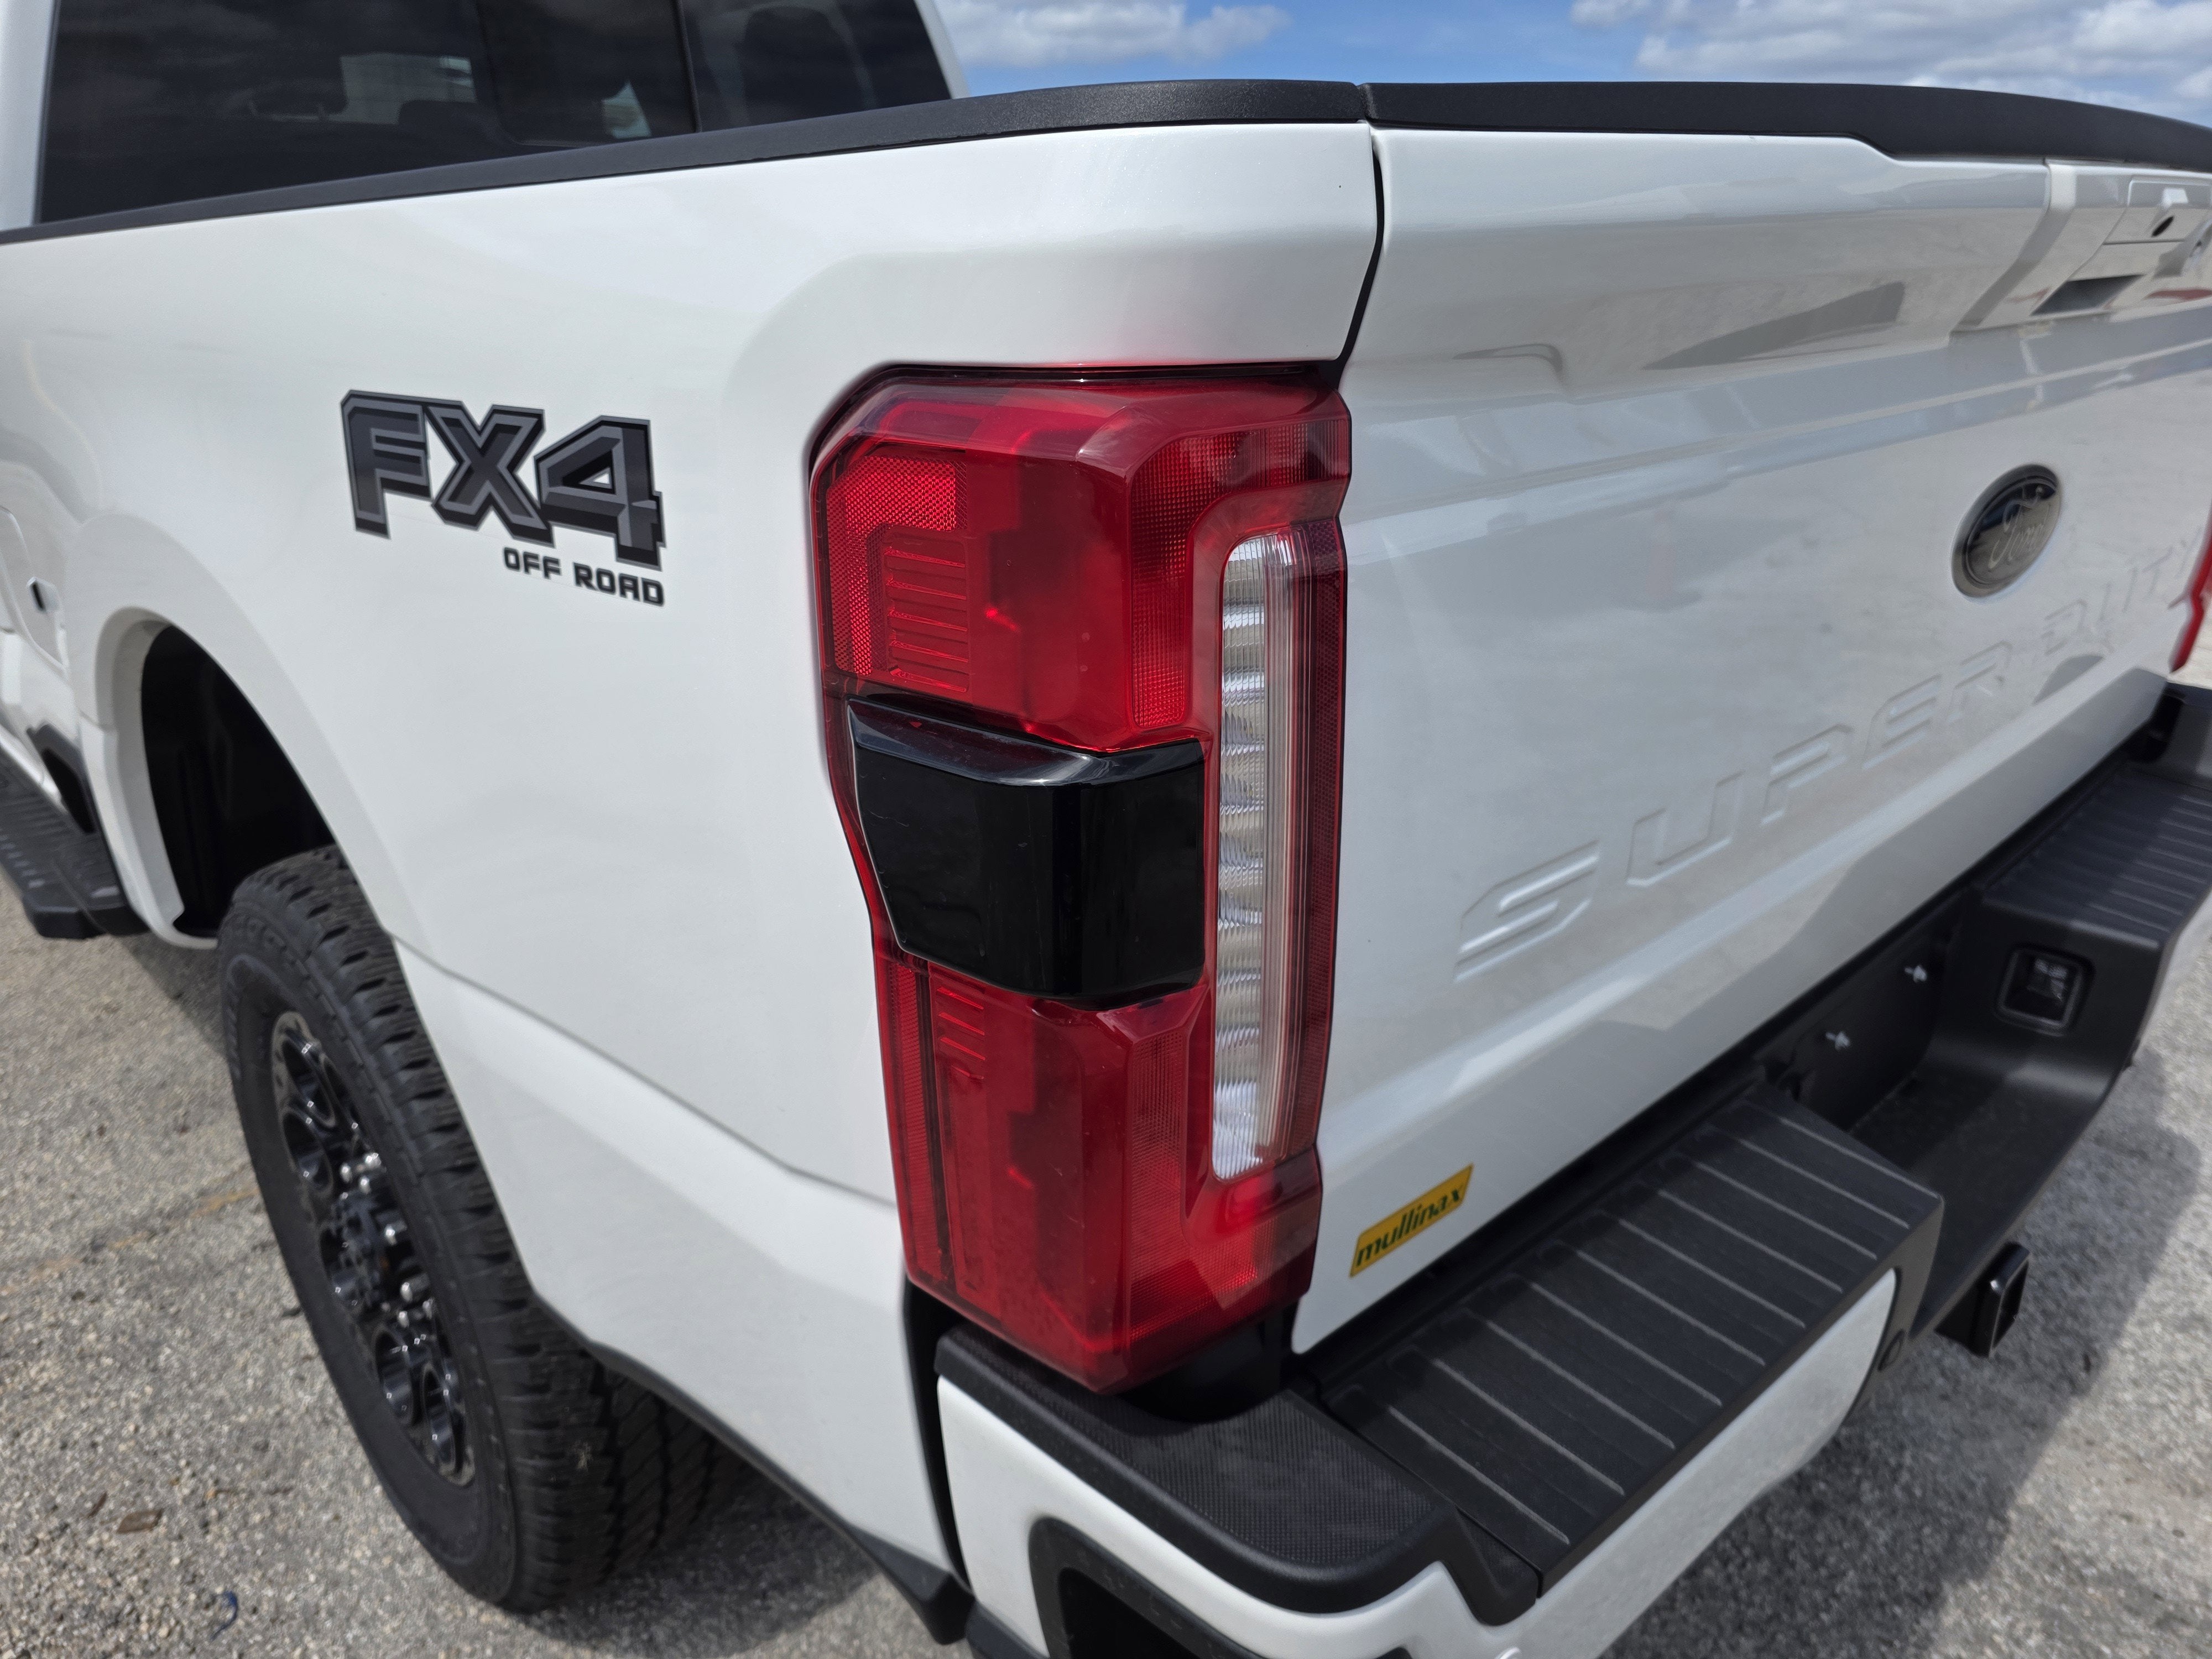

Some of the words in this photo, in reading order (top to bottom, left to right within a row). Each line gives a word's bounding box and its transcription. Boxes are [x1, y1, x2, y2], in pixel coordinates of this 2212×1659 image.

[341, 389, 666, 572] FX4
[1987, 484, 2051, 570] Ford
[503, 547, 562, 579] OFF
[573, 562, 665, 607] ROAD
[1453, 640, 2013, 983] SUPER
